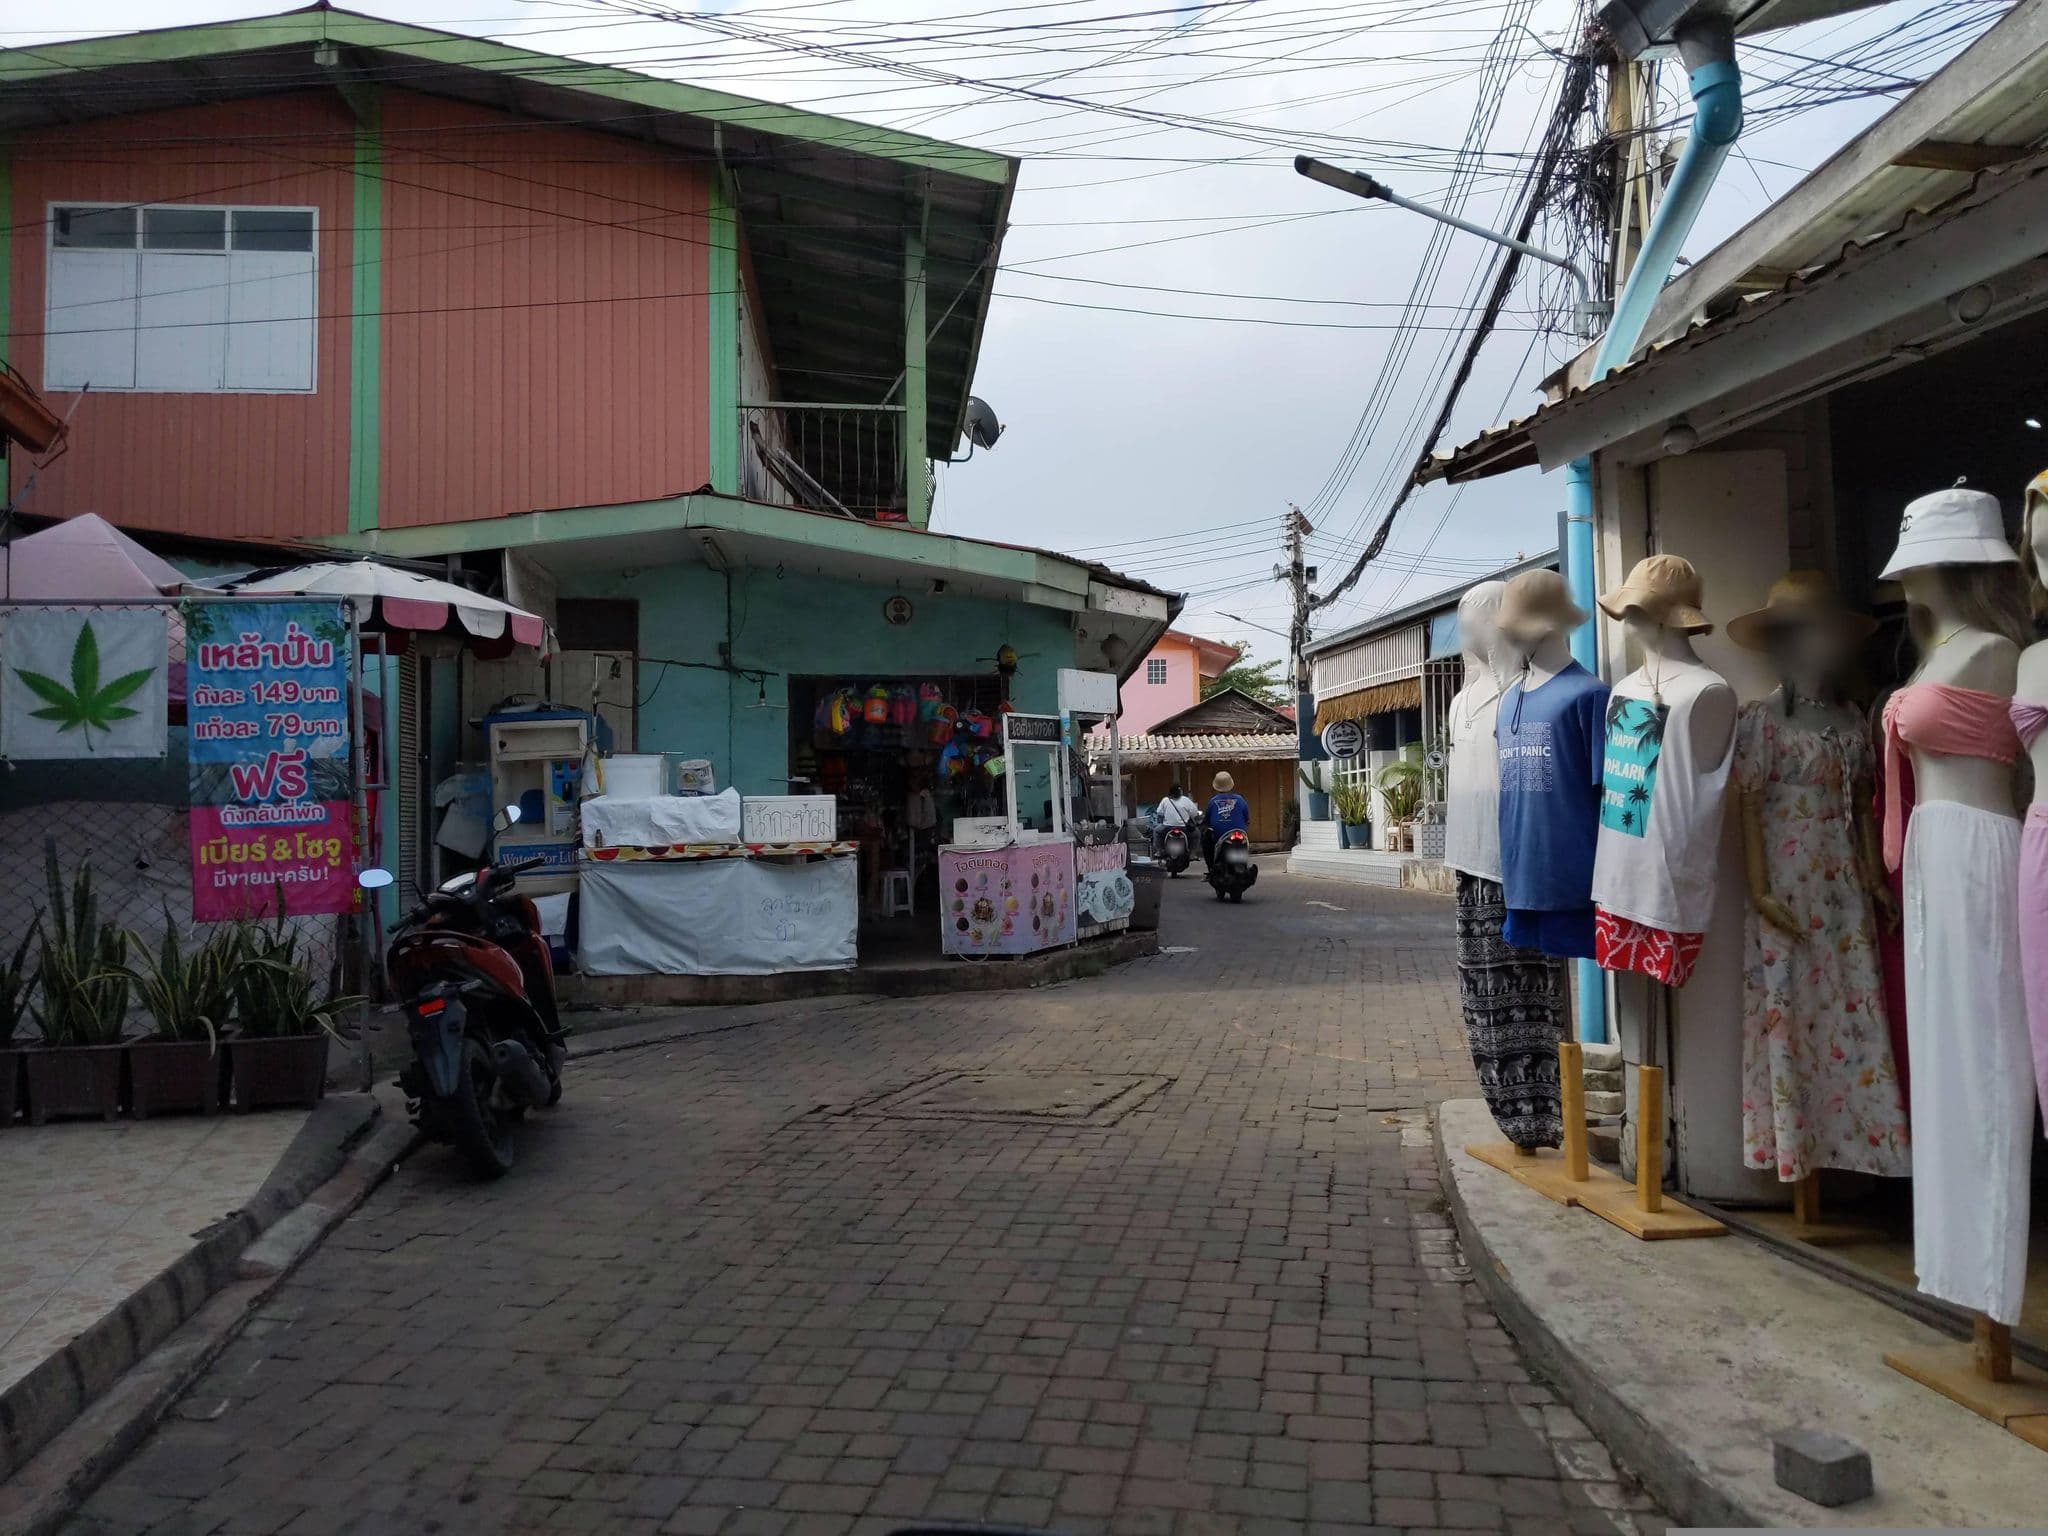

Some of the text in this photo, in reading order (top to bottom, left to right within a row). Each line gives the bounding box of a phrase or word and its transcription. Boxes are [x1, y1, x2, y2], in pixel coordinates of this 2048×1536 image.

[200, 622, 332, 669] เหล้าปั่น
[195, 680, 338, 706] ถังละ 149 บาท
[196, 714, 339, 738] แก้วละ 79 บาท
[1521, 746, 1551, 757] PANIC
[231, 748, 306, 799] ฟรี
[221, 799, 325, 824] ถังกลับที่พัก
[200, 835, 267, 865] เบียร์
[272, 838, 292, 860] &
[295, 832, 342, 866] โซจู
[214, 866, 329, 887] มีขายนะครับ!
